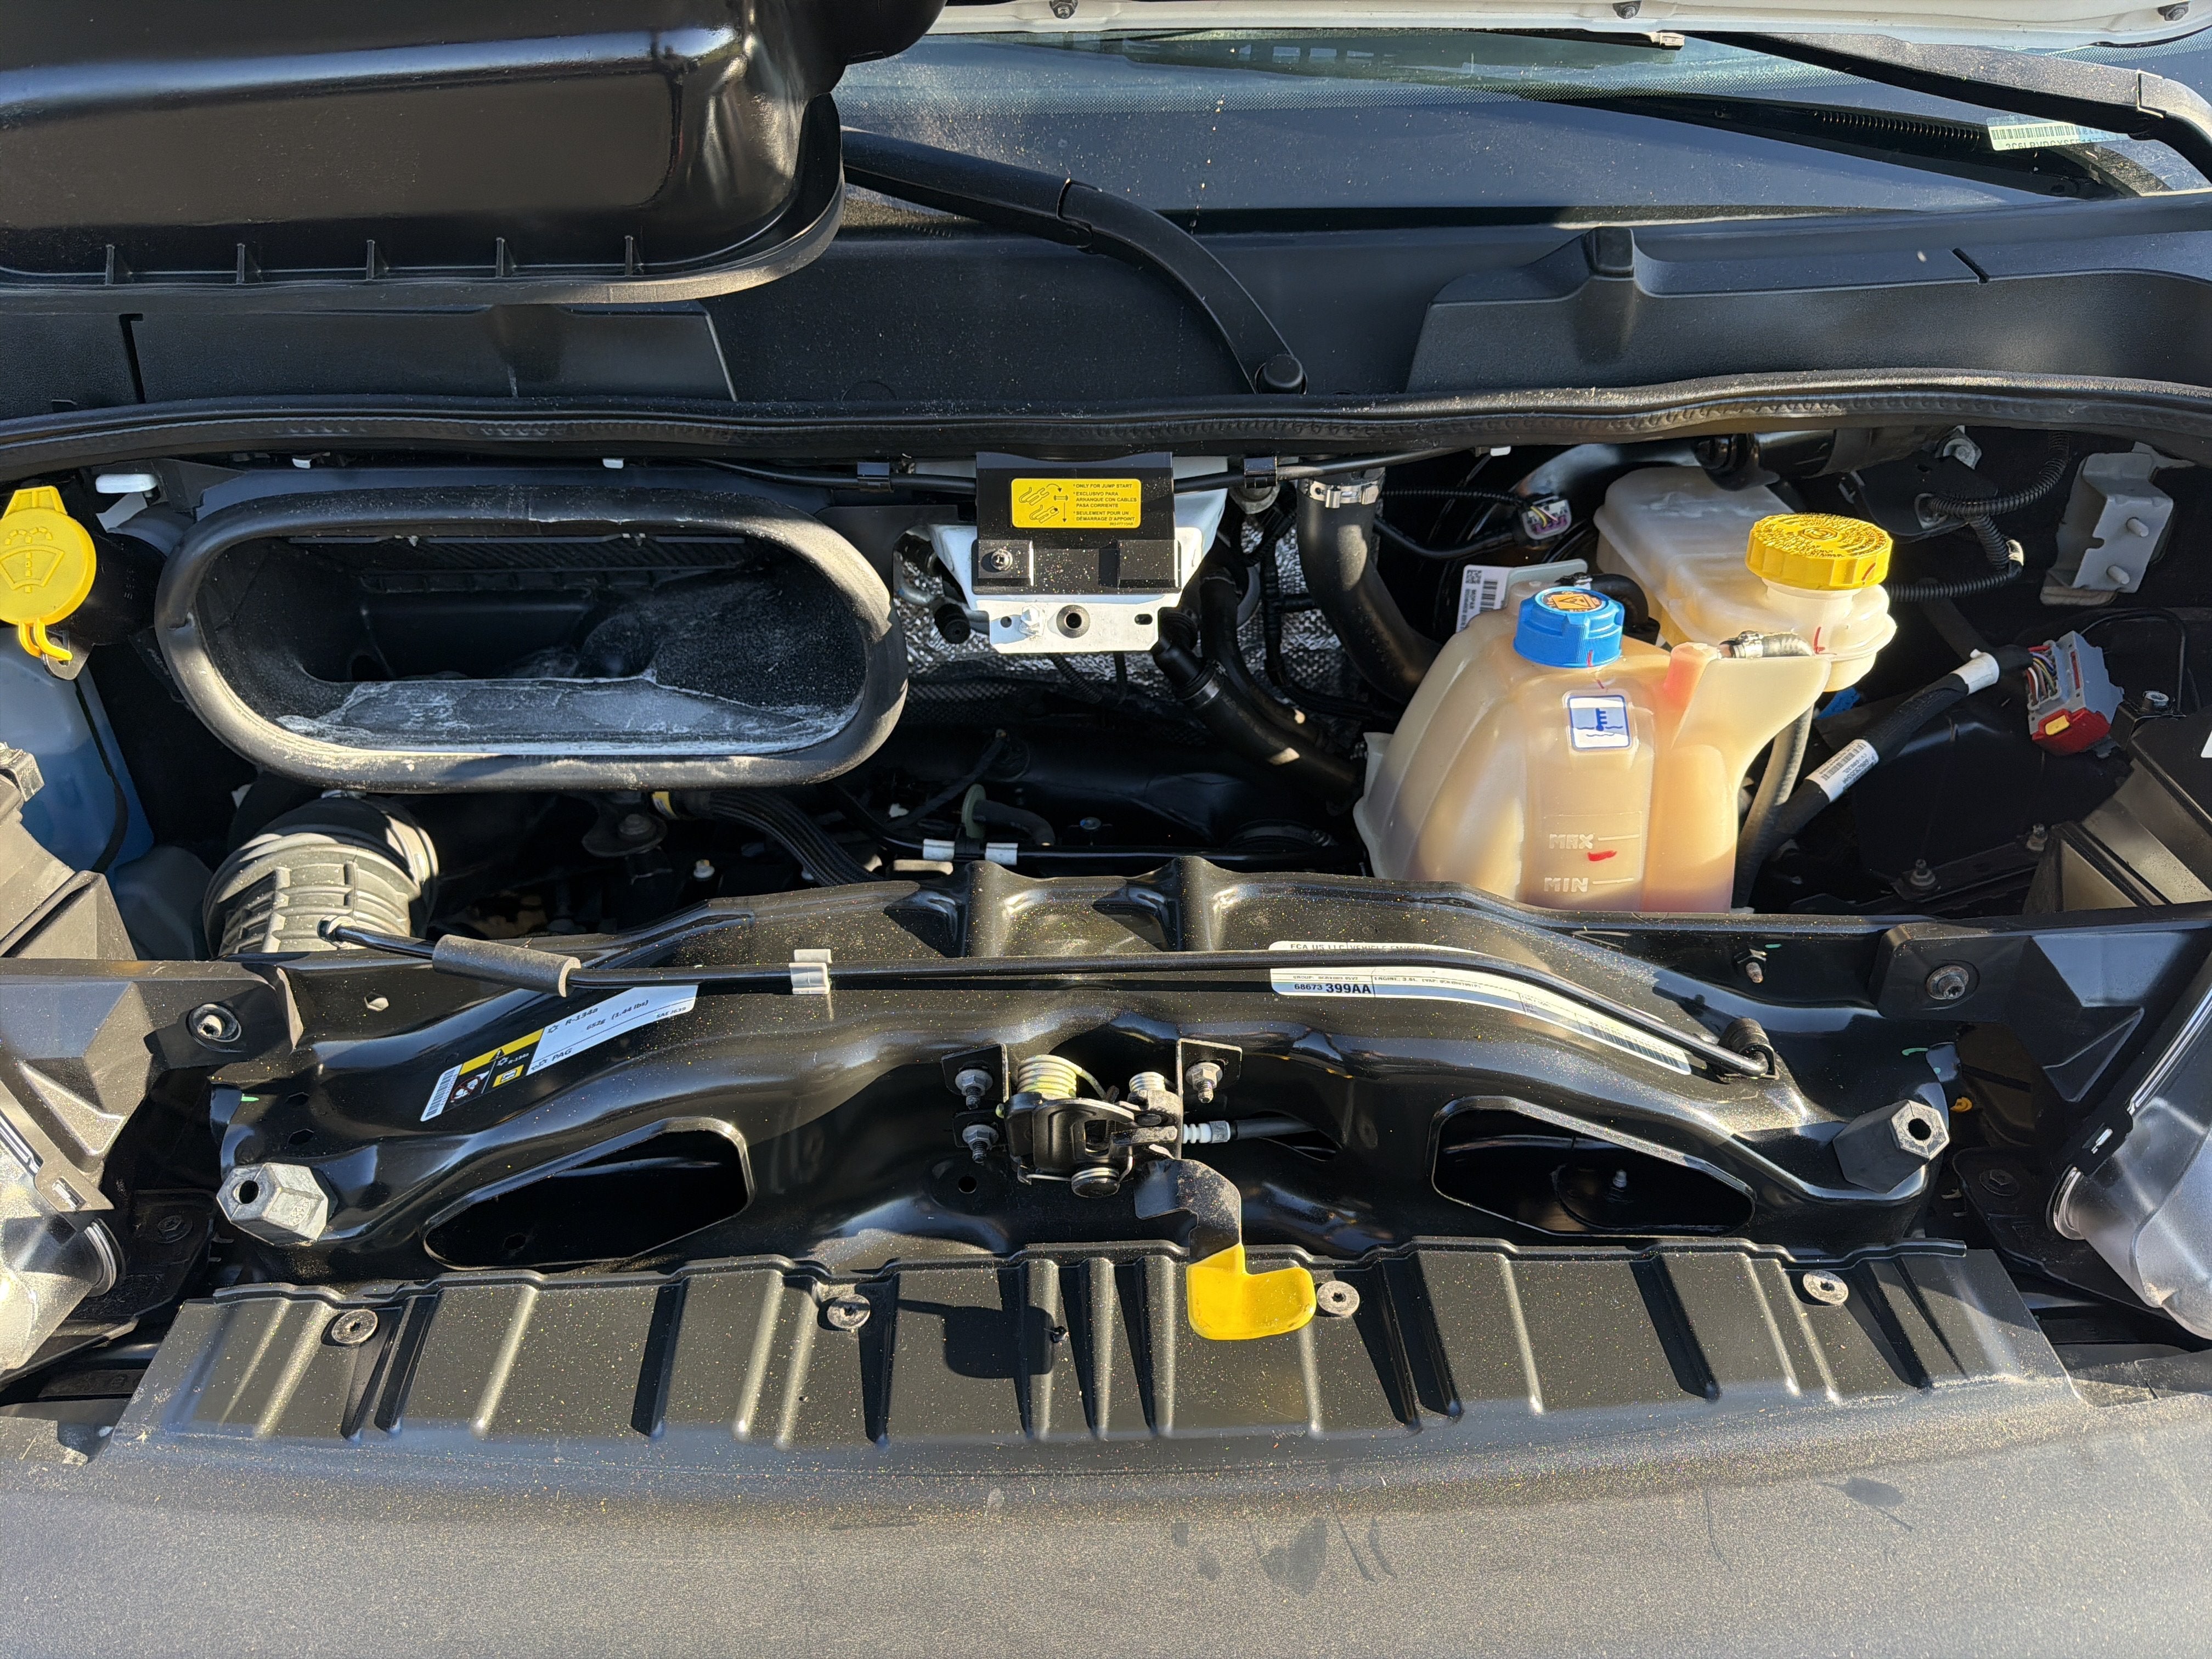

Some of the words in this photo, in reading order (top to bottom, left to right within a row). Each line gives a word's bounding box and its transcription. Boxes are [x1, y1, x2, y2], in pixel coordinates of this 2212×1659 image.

[1548, 833, 1594, 849] MAX
[1543, 877, 1589, 893] MIN
[1325, 983, 1372, 994] 399AA
[565, 1007, 599, 1025] R-134a
[586, 1019, 606, 1030] 652g
[611, 1006, 633, 1020] (1.44
[633, 1000, 649, 1010] lbs)
[669, 1007, 687, 1016] J639
[551, 1047, 573, 1062] PAG
